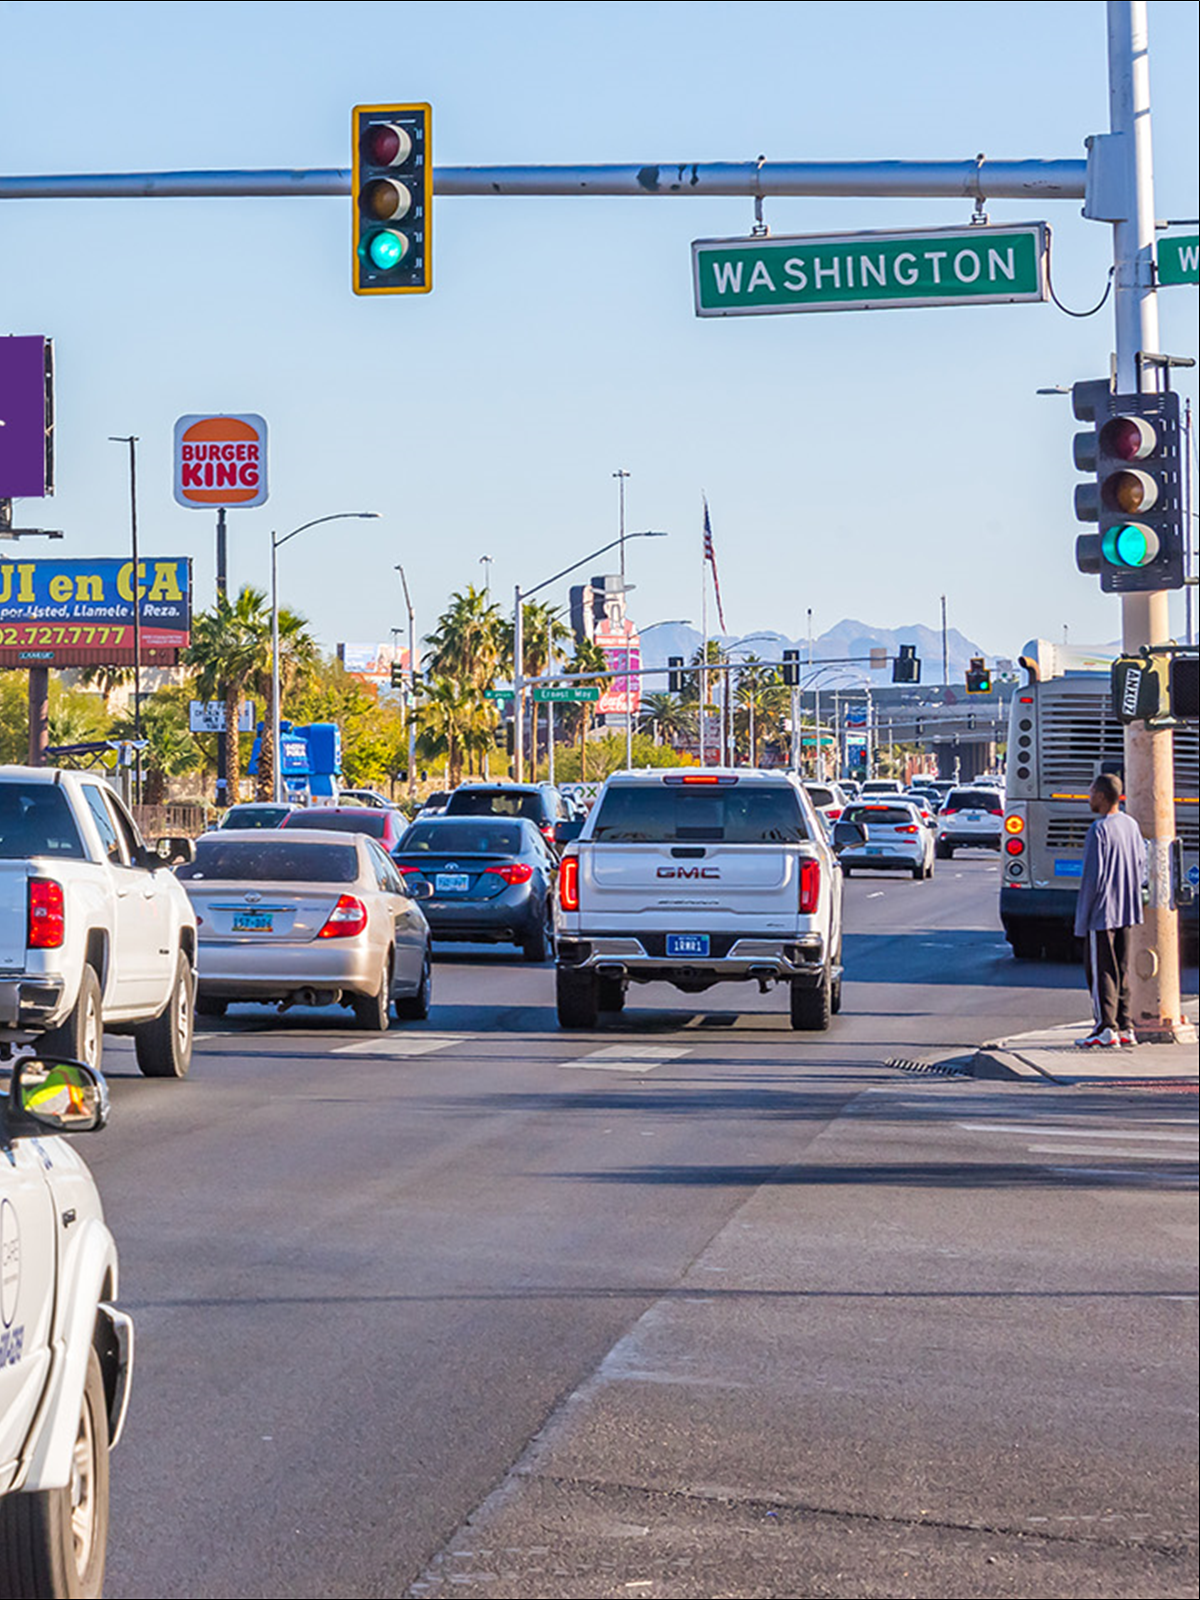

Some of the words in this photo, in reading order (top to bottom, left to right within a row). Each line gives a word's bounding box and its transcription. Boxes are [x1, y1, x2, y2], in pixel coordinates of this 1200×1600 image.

[712, 248, 1016, 294] WASHINGTON
[182, 444, 259, 461] BURGER
[182, 462, 259, 487] KING
[49, 575, 104, 601] en
[116, 562, 183, 602] CA
[143, 603, 180, 617] Reza.
[575, 688, 593, 699] Way
[656, 867, 720, 879] GMC
